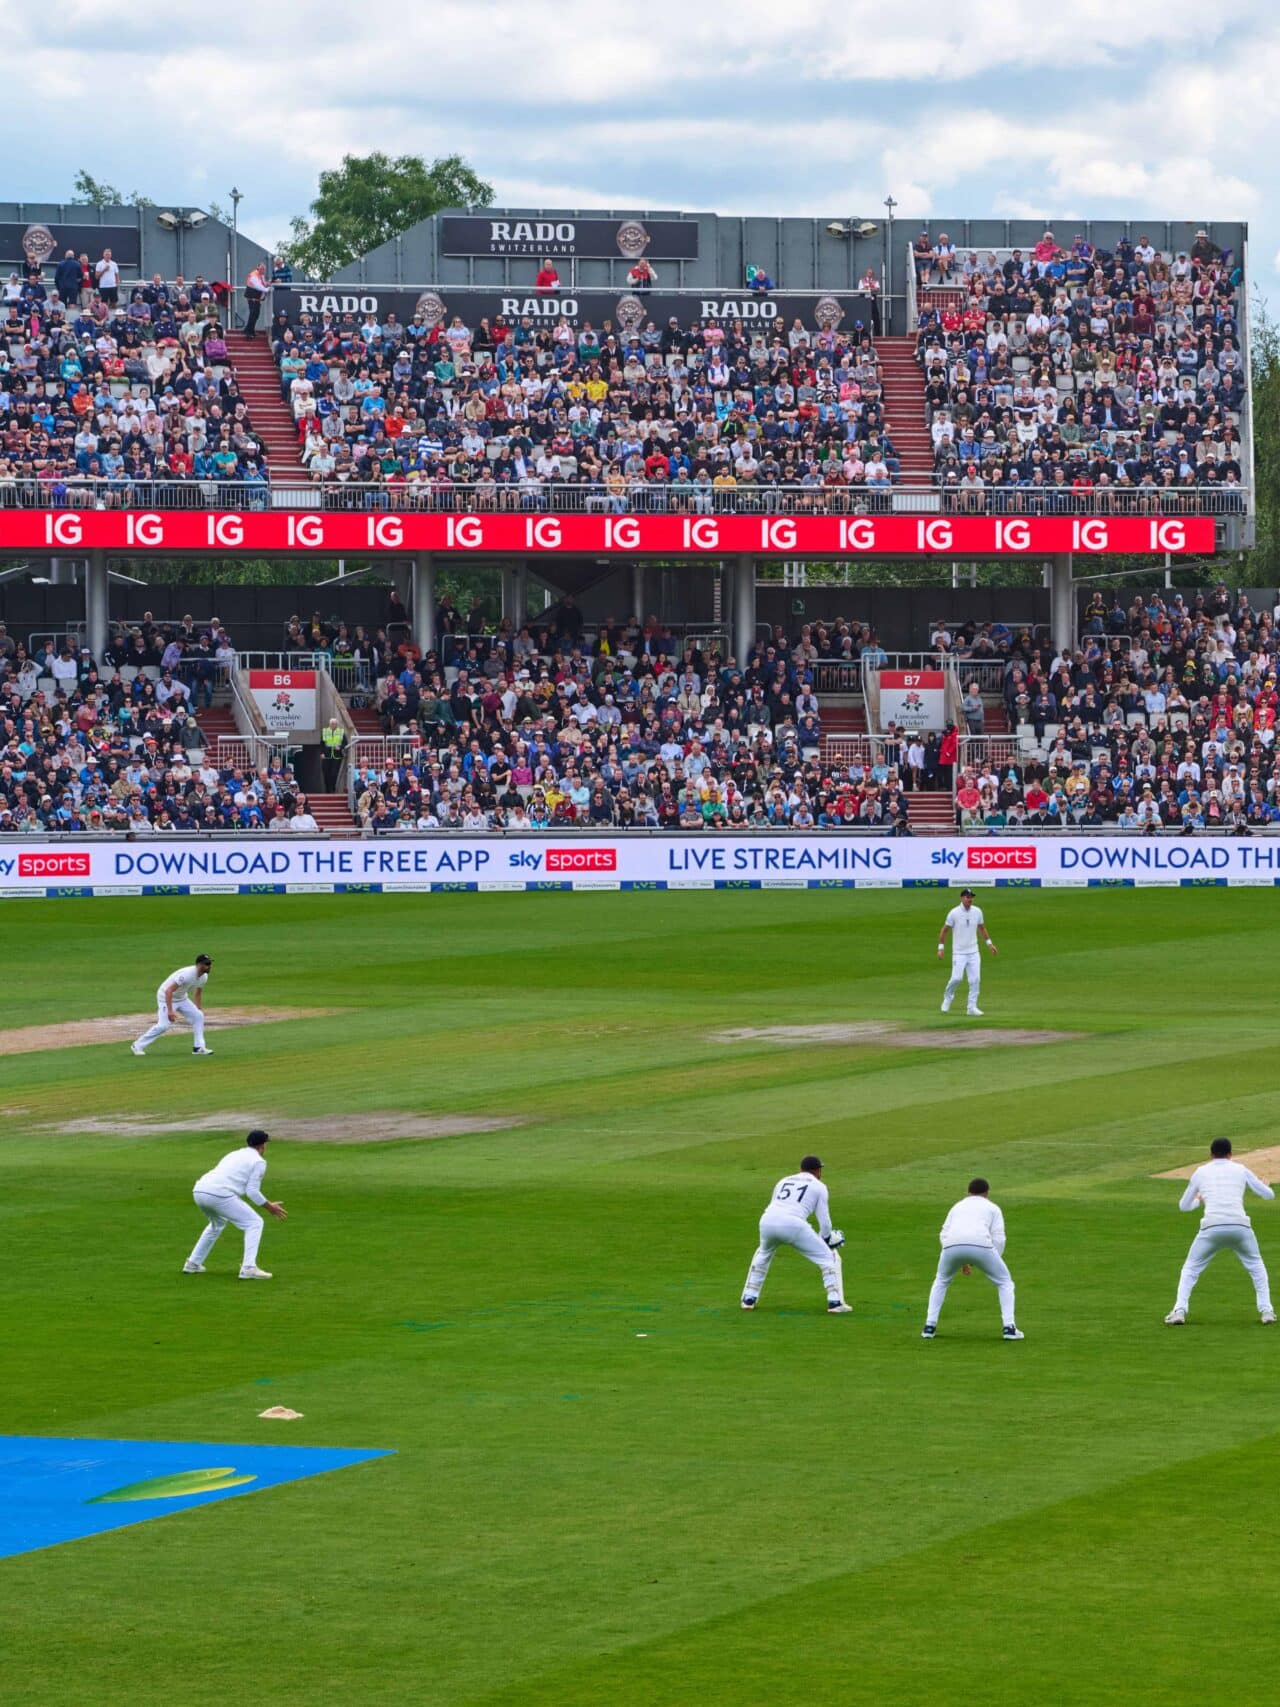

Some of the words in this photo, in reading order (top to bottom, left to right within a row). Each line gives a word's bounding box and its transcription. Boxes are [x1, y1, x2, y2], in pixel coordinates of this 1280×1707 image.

[490, 222, 575, 242] RADO
[490, 244, 576, 253] SWITZERLAND
[300, 295, 378, 313] RADO
[501, 298, 578, 316] RADO
[701, 301, 777, 319] RADO
[46, 514, 82, 544] IG
[127, 514, 163, 545] IG
[208, 515, 243, 545] IG
[288, 516, 323, 546] IG
[368, 517, 403, 546] IG
[447, 517, 482, 547] IG
[527, 518, 561, 547] IG
[605, 518, 640, 548] IG
[684, 518, 718, 548] IG
[762, 519, 796, 549] IG
[840, 519, 874, 549] IG
[918, 520, 952, 549] IG
[996, 520, 1030, 549] IG
[1073, 520, 1107, 550] IG
[1151, 520, 1185, 550] IG
[273, 674, 291, 685] B6
[904, 675, 920, 685] B7
[22, 856, 87, 875] sports
[115, 852, 290, 875] DOWNLOAD
[298, 851, 353, 873] THE
[363, 850, 428, 872] FREE
[435, 850, 490, 872] APP
[509, 850, 543, 870] sky
[549, 851, 613, 870] sports
[669, 848, 725, 870] LIVE
[733, 847, 892, 870] STREAMING
[931, 848, 964, 868] sky
[970, 849, 1033, 868] sports
[1060, 847, 1229, 869] DOWNLOAD
[777, 1183, 808, 1202] 51
